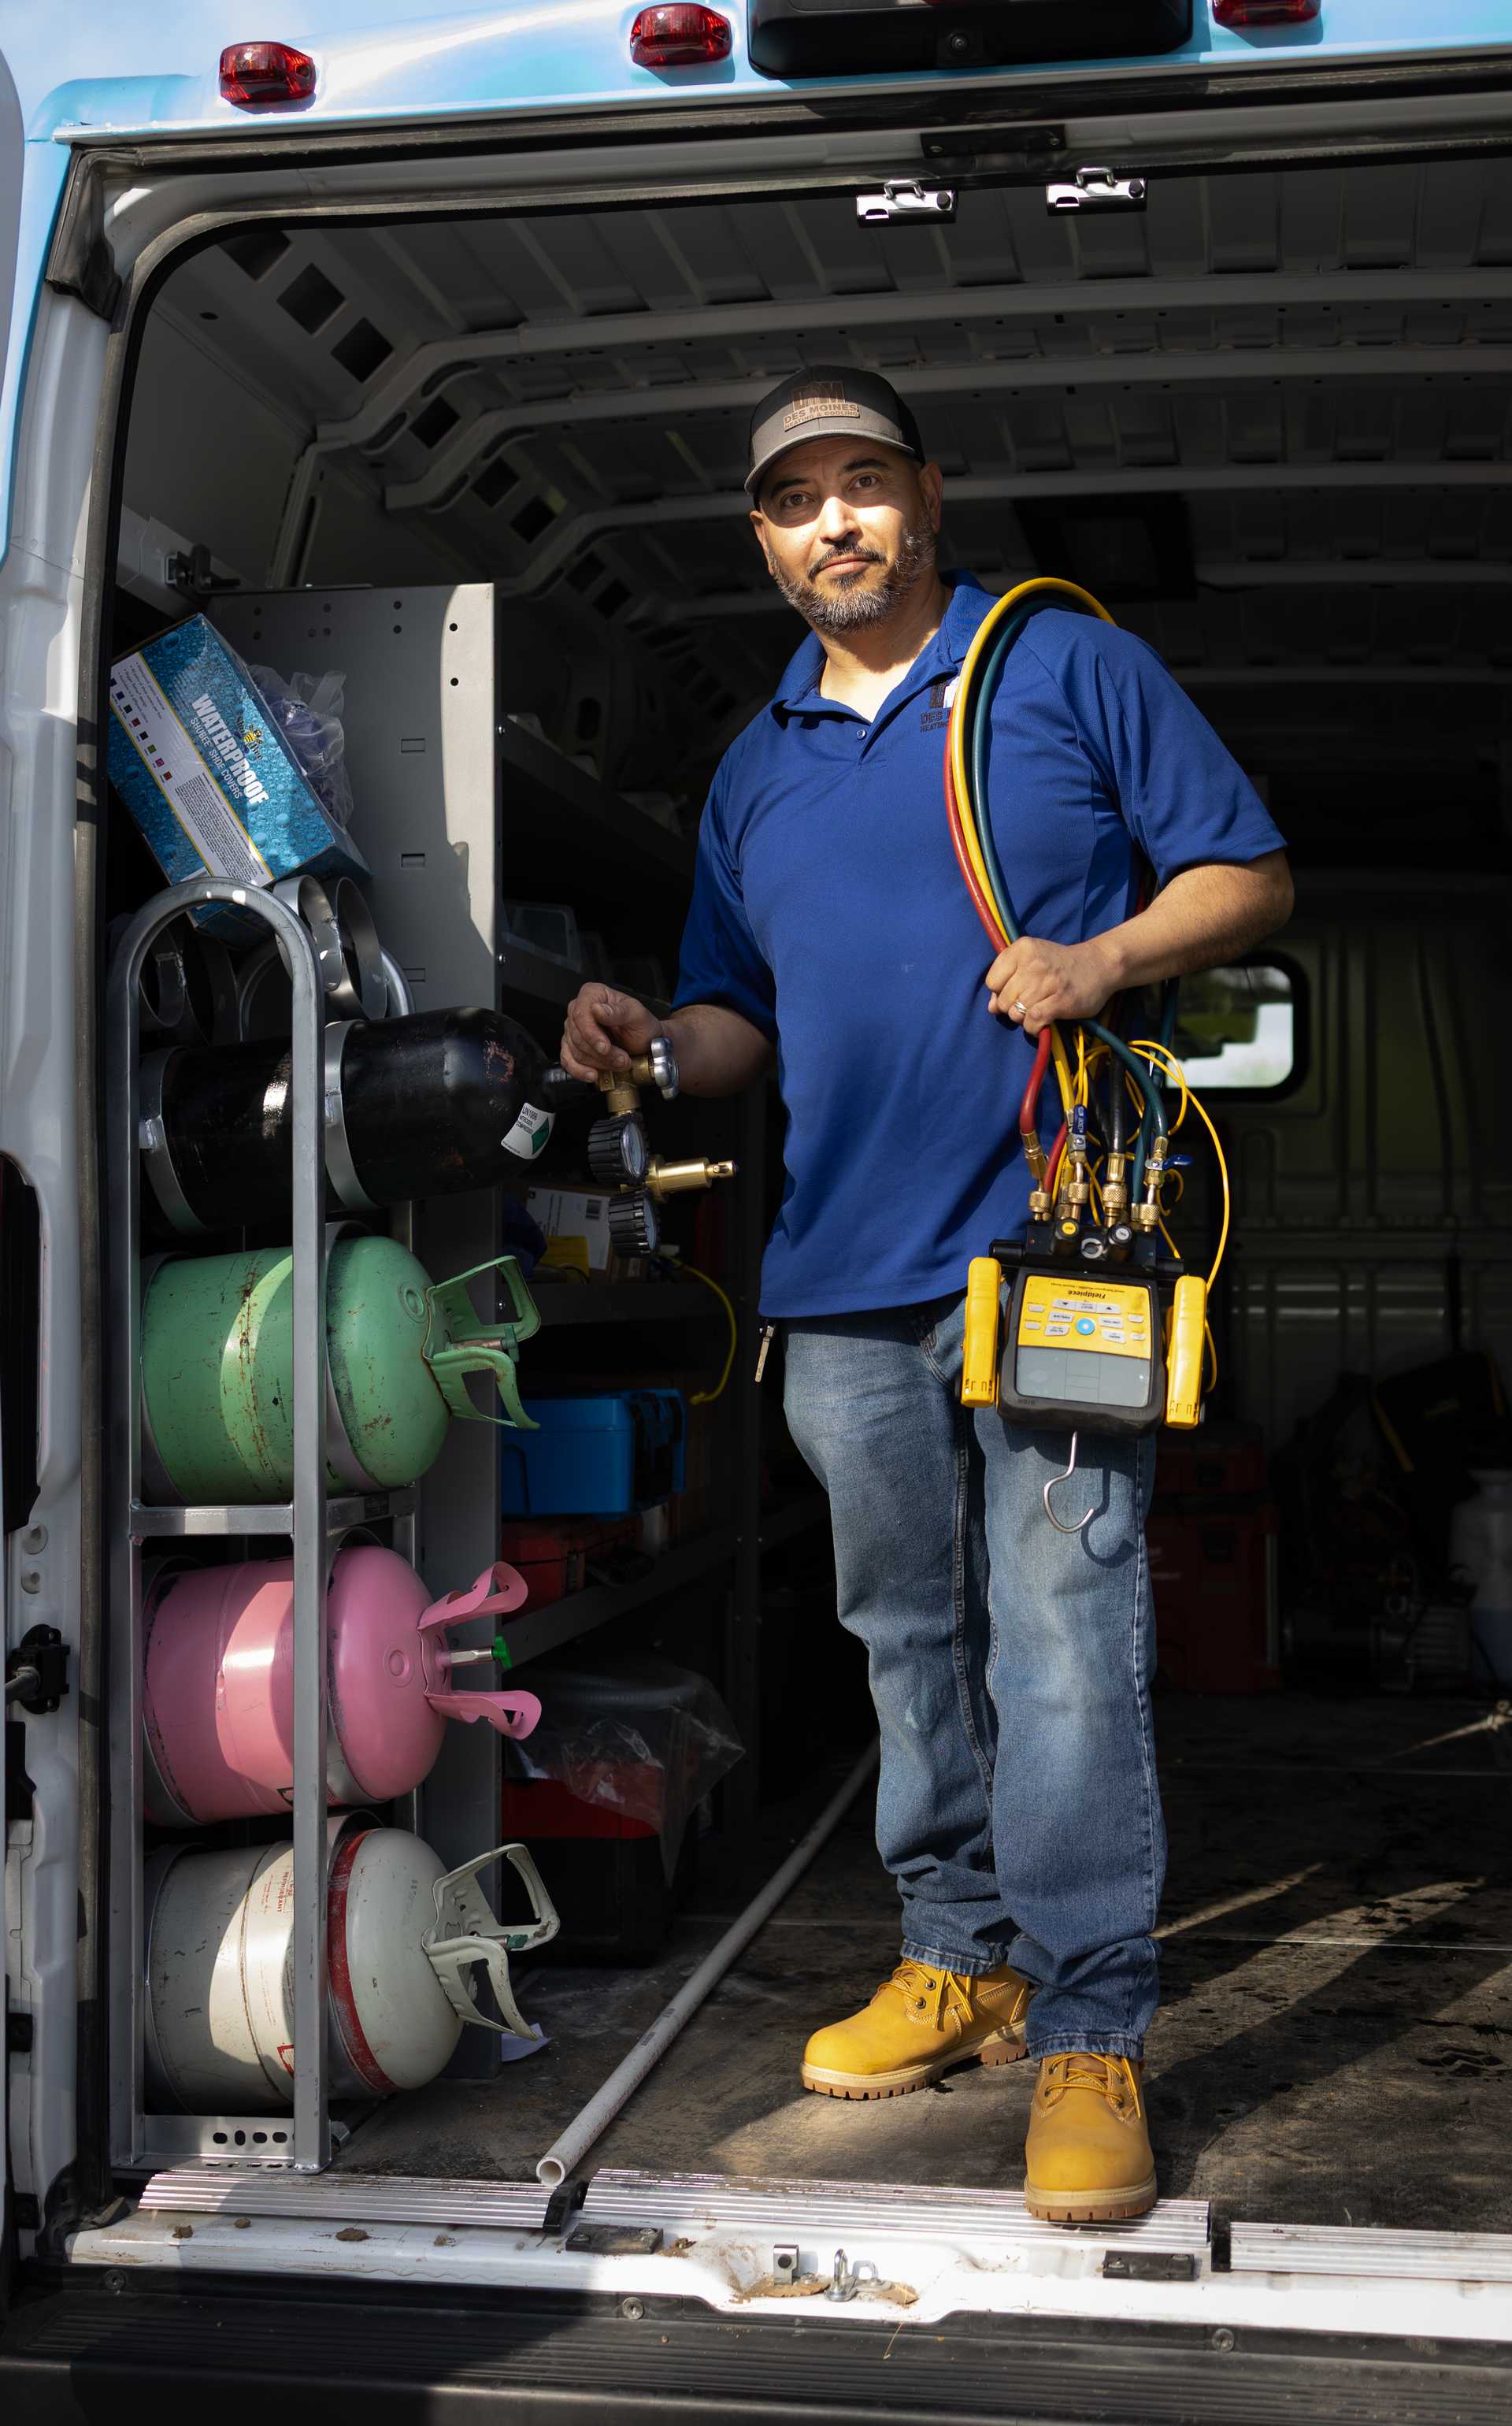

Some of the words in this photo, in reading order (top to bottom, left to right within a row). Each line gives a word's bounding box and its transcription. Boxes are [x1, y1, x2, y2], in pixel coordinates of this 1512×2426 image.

[784, 410, 806, 424] DES
[810, 403, 858, 414] MOINES
[784, 414, 815, 429] HEATING
[190, 718, 212, 748] SHUBEE
[208, 748, 225, 772] SHOE
[220, 769, 243, 800] COVERS
[191, 693, 270, 805] WATERPROOF
[1067, 1289, 1106, 1300] Fieldpiece
[277, 1871, 290, 1913] REFRIGERANT
